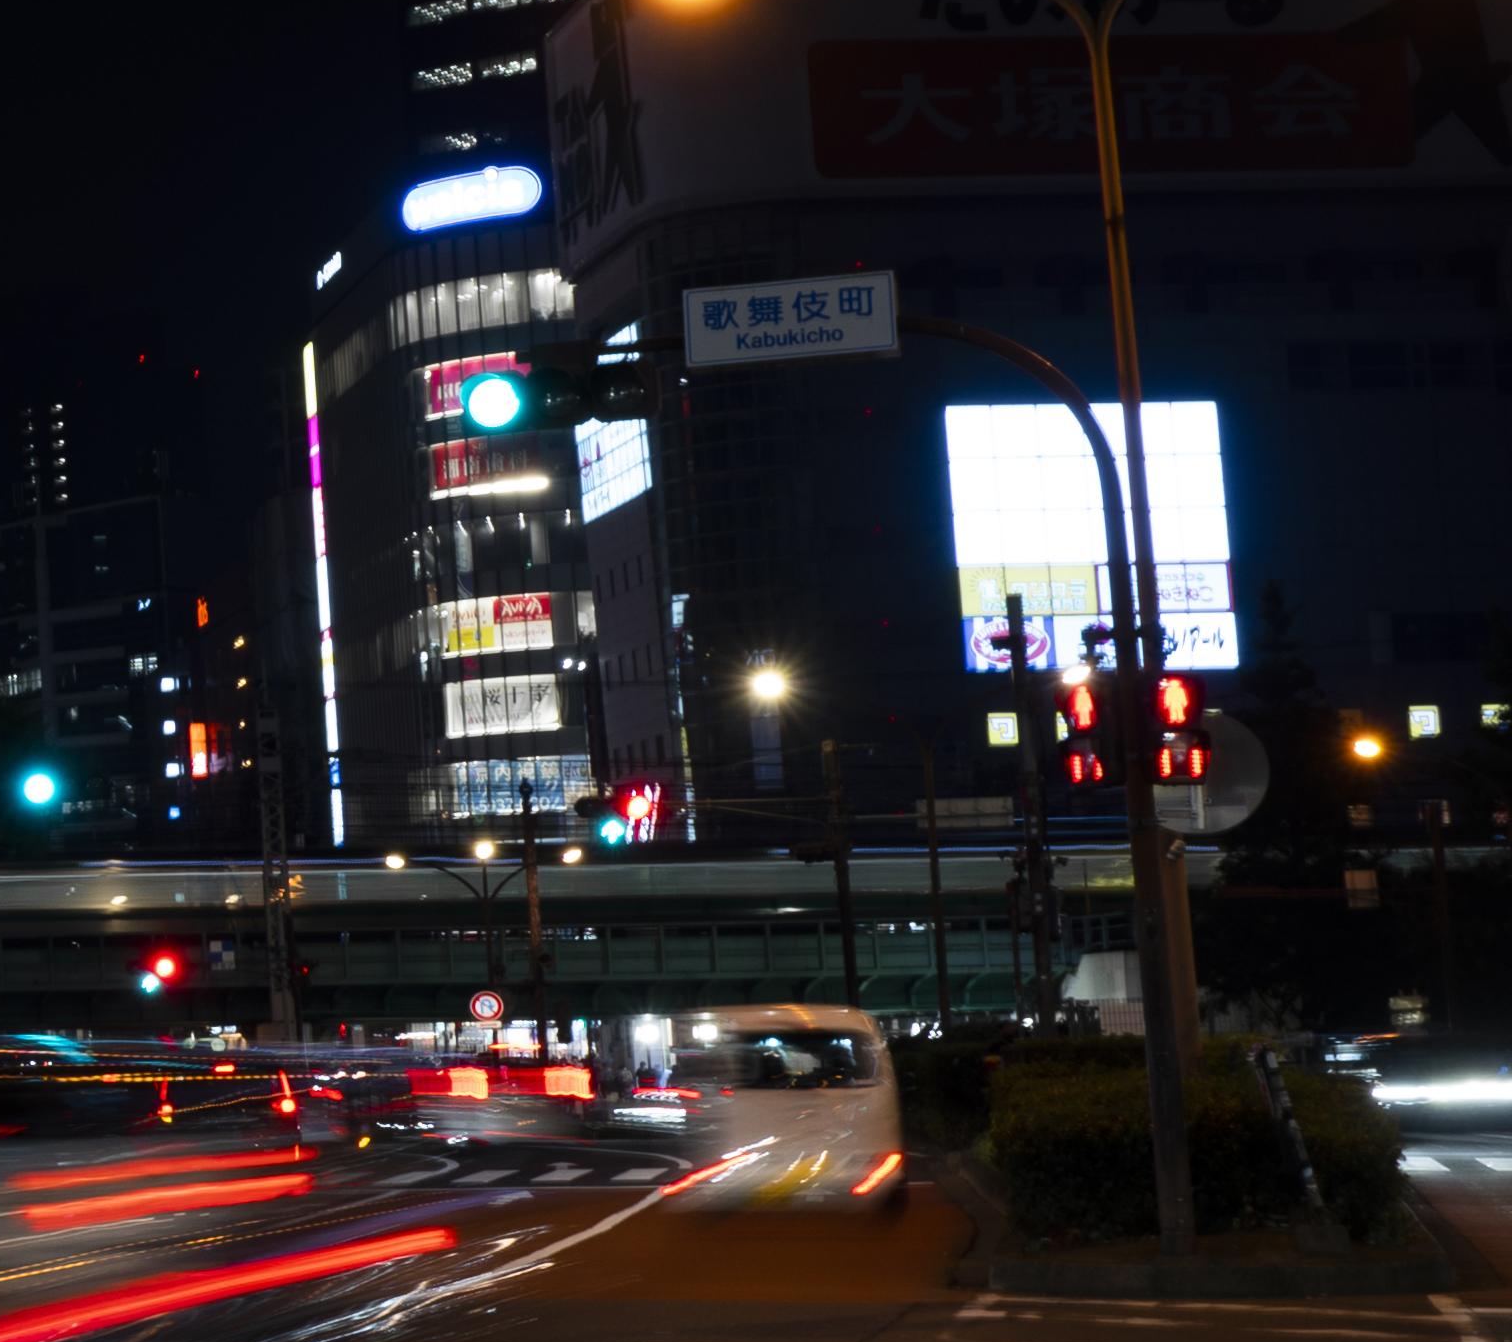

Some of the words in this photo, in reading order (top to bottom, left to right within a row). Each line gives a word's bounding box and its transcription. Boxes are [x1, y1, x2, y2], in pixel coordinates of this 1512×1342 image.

[859, 63, 1360, 144] 大塚商会
[701, 285, 875, 331] 歌舞伎町
[735, 326, 845, 350] Kabukicho
